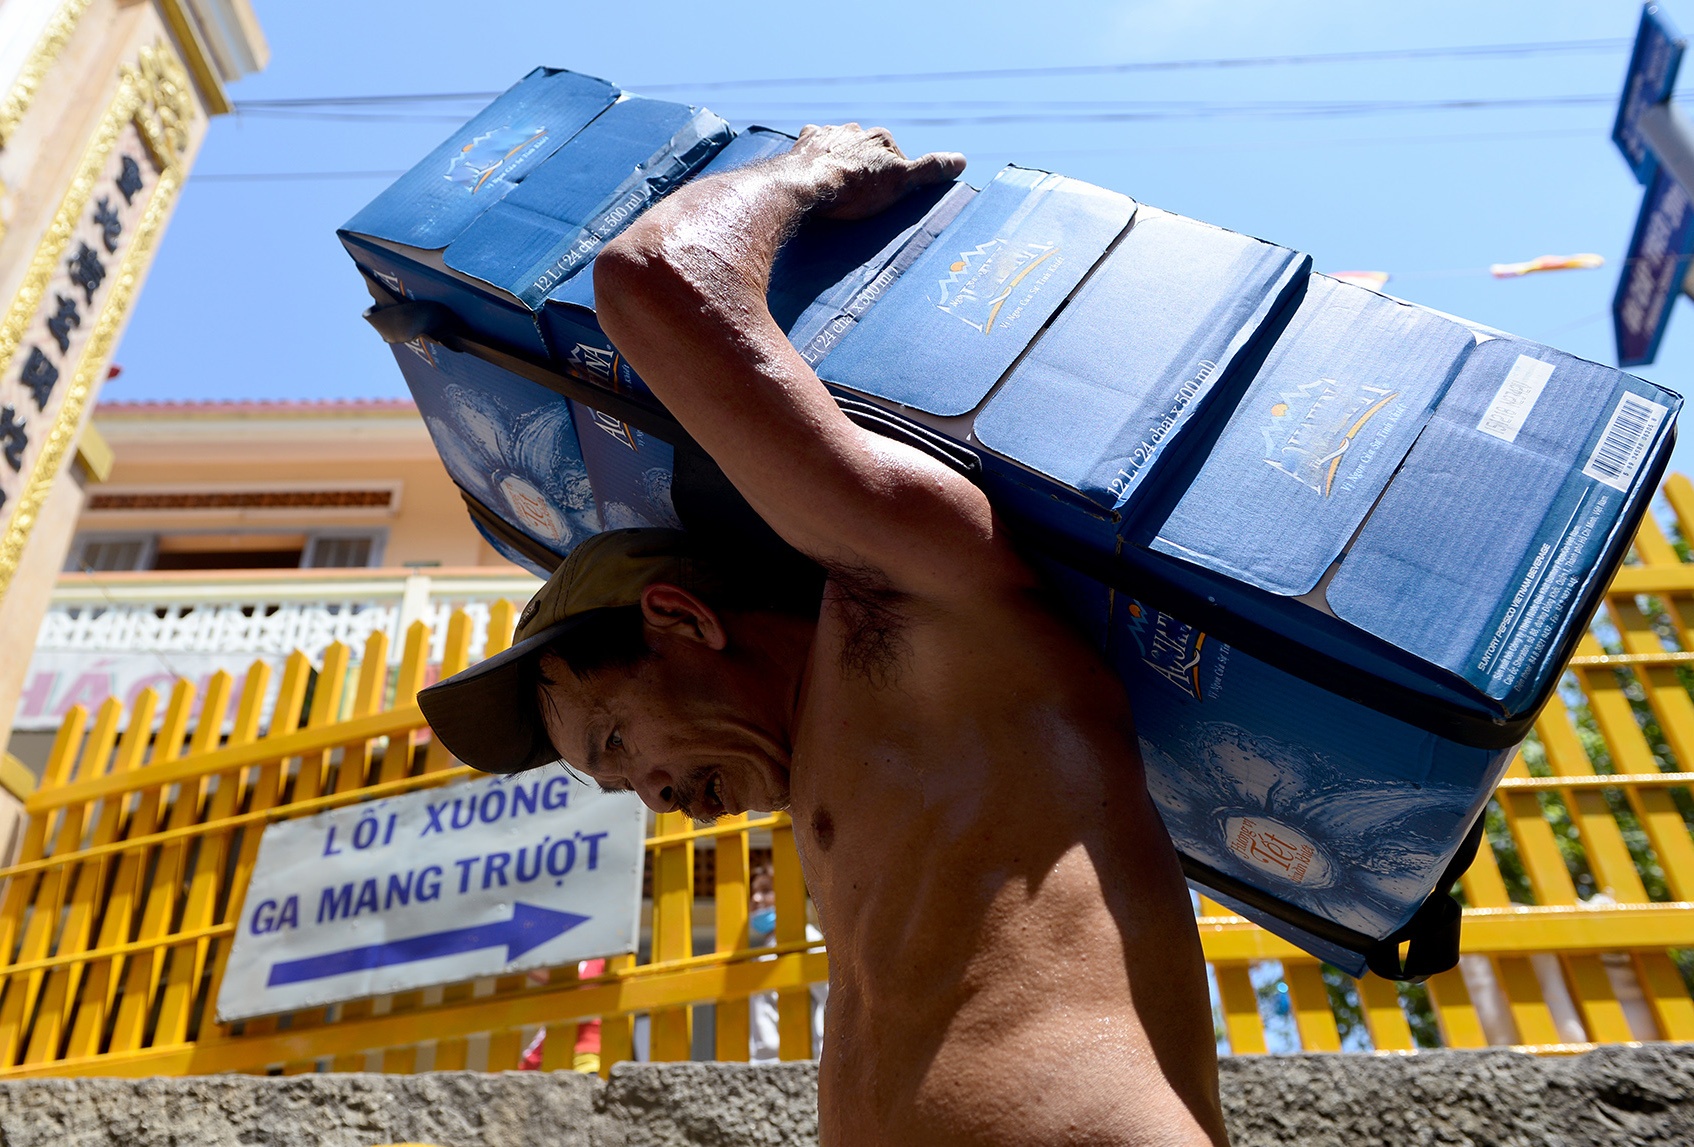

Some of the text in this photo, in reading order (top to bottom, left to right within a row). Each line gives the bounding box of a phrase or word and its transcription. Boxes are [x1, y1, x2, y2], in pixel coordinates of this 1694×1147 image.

[533, 187, 647, 292] 12 L ( 24 chai x 500 ml )
[876, 268, 894, 287] ml
[856, 282, 880, 305] 500
[850, 300, 864, 313] x
[831, 308, 856, 333] chai
[809, 340, 825, 353] (
[816, 330, 836, 347] 24
[799, 351, 817, 364] L
[1108, 360, 1218, 499] 12 L ( 24 chai x 500 ml )
[1478, 543, 1550, 670] SUNTORY PEPSICO VIETNAM BEVERAGE
[1220, 644, 1230, 654] Tin
[322, 801, 397, 857] LỐI
[1251, 832, 1297, 871] Tết
[250, 830, 608, 935] GA MANG TRƯỢT
